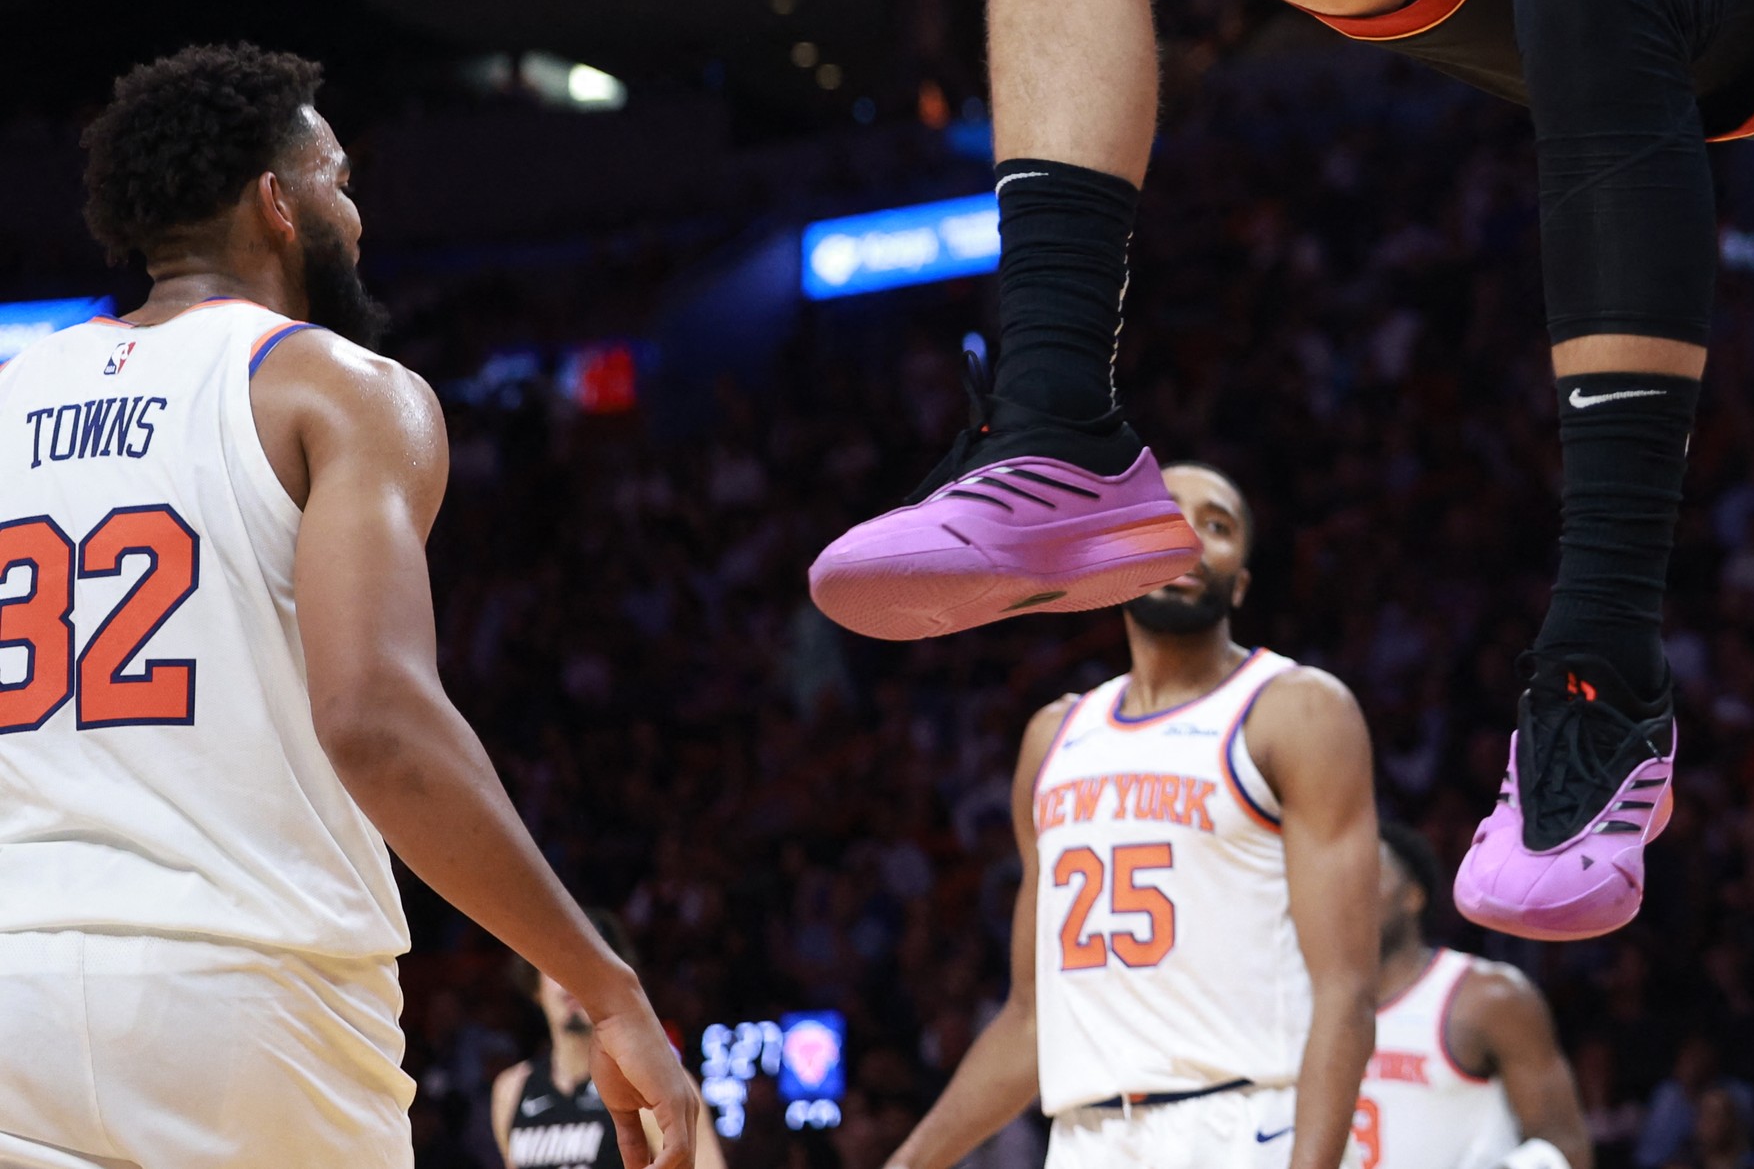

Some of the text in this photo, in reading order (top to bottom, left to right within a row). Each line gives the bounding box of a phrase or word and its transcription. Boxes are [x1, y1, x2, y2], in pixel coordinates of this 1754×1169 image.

[26, 395, 168, 469] TOWNS
[0, 503, 200, 734] 32
[1036, 772, 1217, 834] NEW YORK
[1054, 842, 1175, 972] 25
